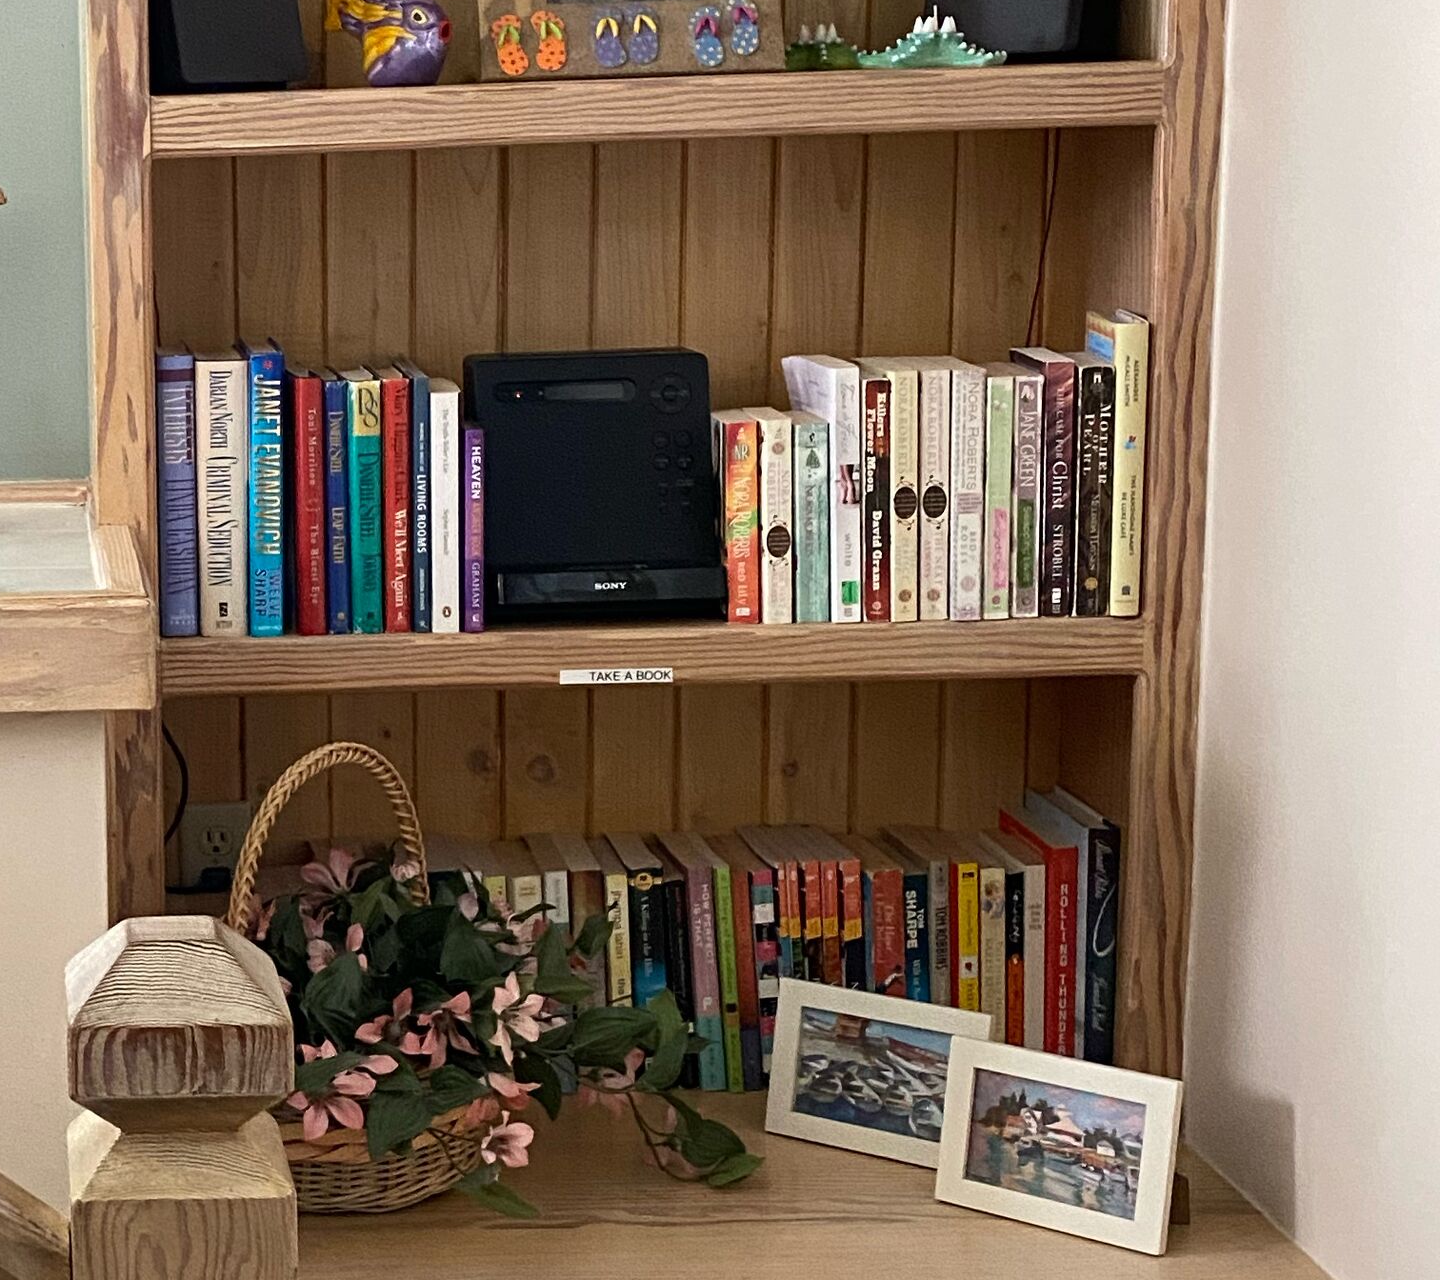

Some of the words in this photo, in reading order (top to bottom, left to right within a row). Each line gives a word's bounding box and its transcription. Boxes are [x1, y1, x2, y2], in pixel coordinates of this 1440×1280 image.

[209, 370, 233, 411] DARIAN
[253, 374, 281, 437] JANET
[898, 376, 908, 413] NORA
[927, 376, 937, 413] NORA
[967, 381, 980, 421] NORA
[209, 412, 234, 449] NORTH
[308, 407, 317, 431] Toni
[866, 408, 876, 454] Flower
[876, 392, 886, 437] Killers
[1020, 407, 1038, 440] JANE
[308, 436, 317, 486] Morrison
[898, 417, 908, 474] ROBERTS
[927, 416, 937, 474] ROBERTS
[966, 426, 980, 490] ROBERTS
[1083, 412, 1095, 476] PEARL
[1092, 433, 1099, 451] OF
[1097, 402, 1111, 484] MOTHER
[471, 446, 481, 499] HEAVEN
[866, 455, 876, 493] Moon
[1020, 444, 1037, 486] GREEN
[1051, 460, 1068, 509] Christ
[206, 456, 239, 518] CRIMINAL
[252, 443, 281, 555] EVANOVICH
[417, 474, 426, 510] LIVING
[732, 476, 751, 509] NORA
[310, 524, 319, 544] The
[417, 514, 426, 553] ROOMS
[729, 510, 751, 558] ROBERTS
[872, 509, 883, 547] David
[205, 519, 240, 587] SEDUCTION
[394, 538, 406, 568] Meet
[844, 533, 853, 566] white
[872, 549, 883, 590] Grann
[1052, 523, 1063, 581] STROBEL
[255, 568, 267, 617] SHARP
[269, 566, 281, 619] TWELVE
[309, 586, 320, 604] Eye
[391, 571, 406, 608] Again
[471, 562, 481, 608] GRAHAM
[594, 582, 627, 590] SONY
[589, 671, 621, 682] TAKE
[624, 671, 633, 681] A
[636, 670, 672, 680] BOOK
[693, 903, 701, 914] IS
[701, 883, 711, 910] HOW
[935, 905, 948, 925] TOM
[693, 918, 703, 947] THAT
[702, 913, 714, 964] PERFECT
[905, 890, 918, 949] SHARPE
[916, 908, 925, 929] TOM
[935, 928, 948, 970] ROBBINS
[1058, 974, 1067, 1055] THUNDER
